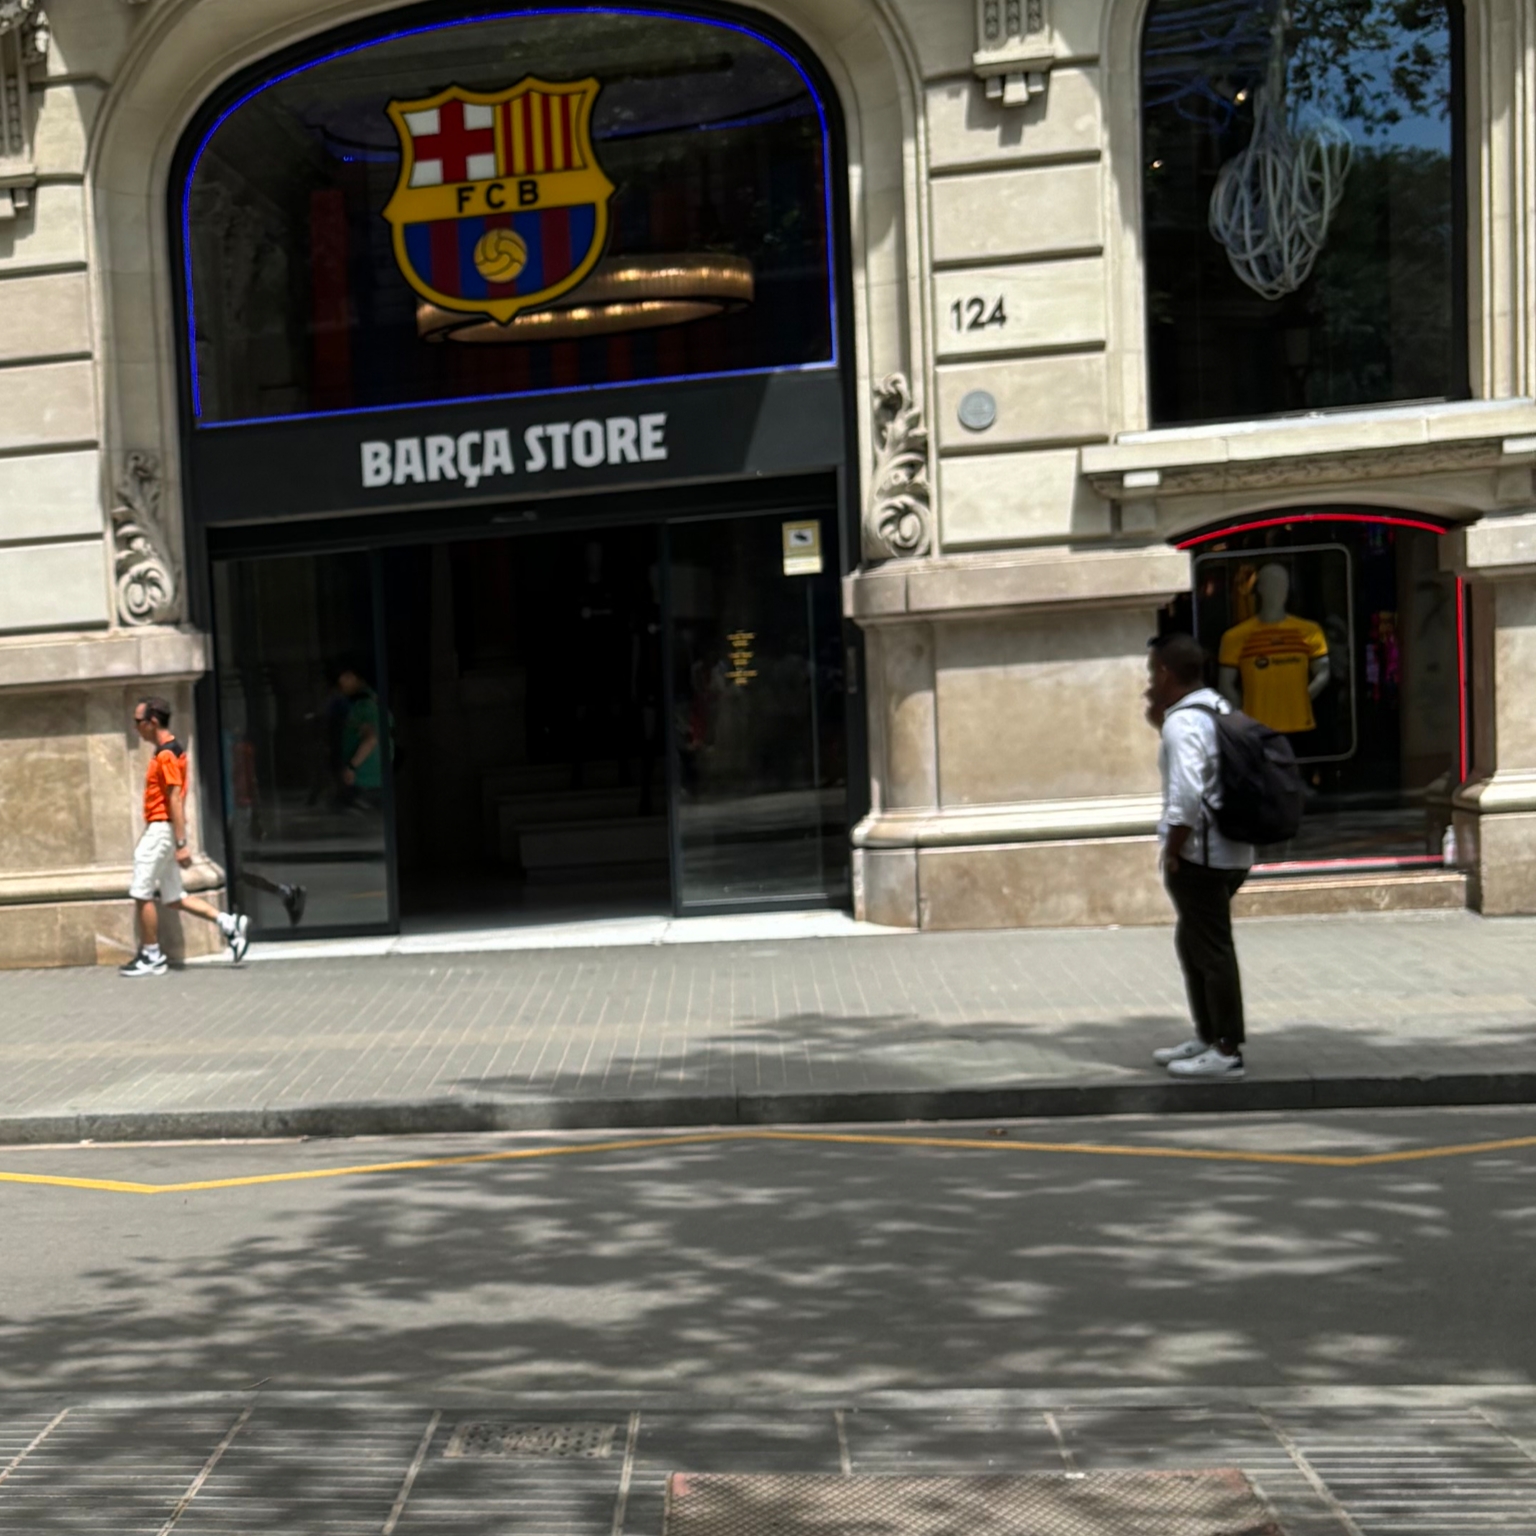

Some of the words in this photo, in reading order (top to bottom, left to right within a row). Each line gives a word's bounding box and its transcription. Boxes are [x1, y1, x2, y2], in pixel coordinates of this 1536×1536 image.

[455, 180, 539, 213] FCB
[951, 294, 1007, 332] 124
[361, 427, 514, 488] BARÇA
[524, 412, 668, 473] STORE
